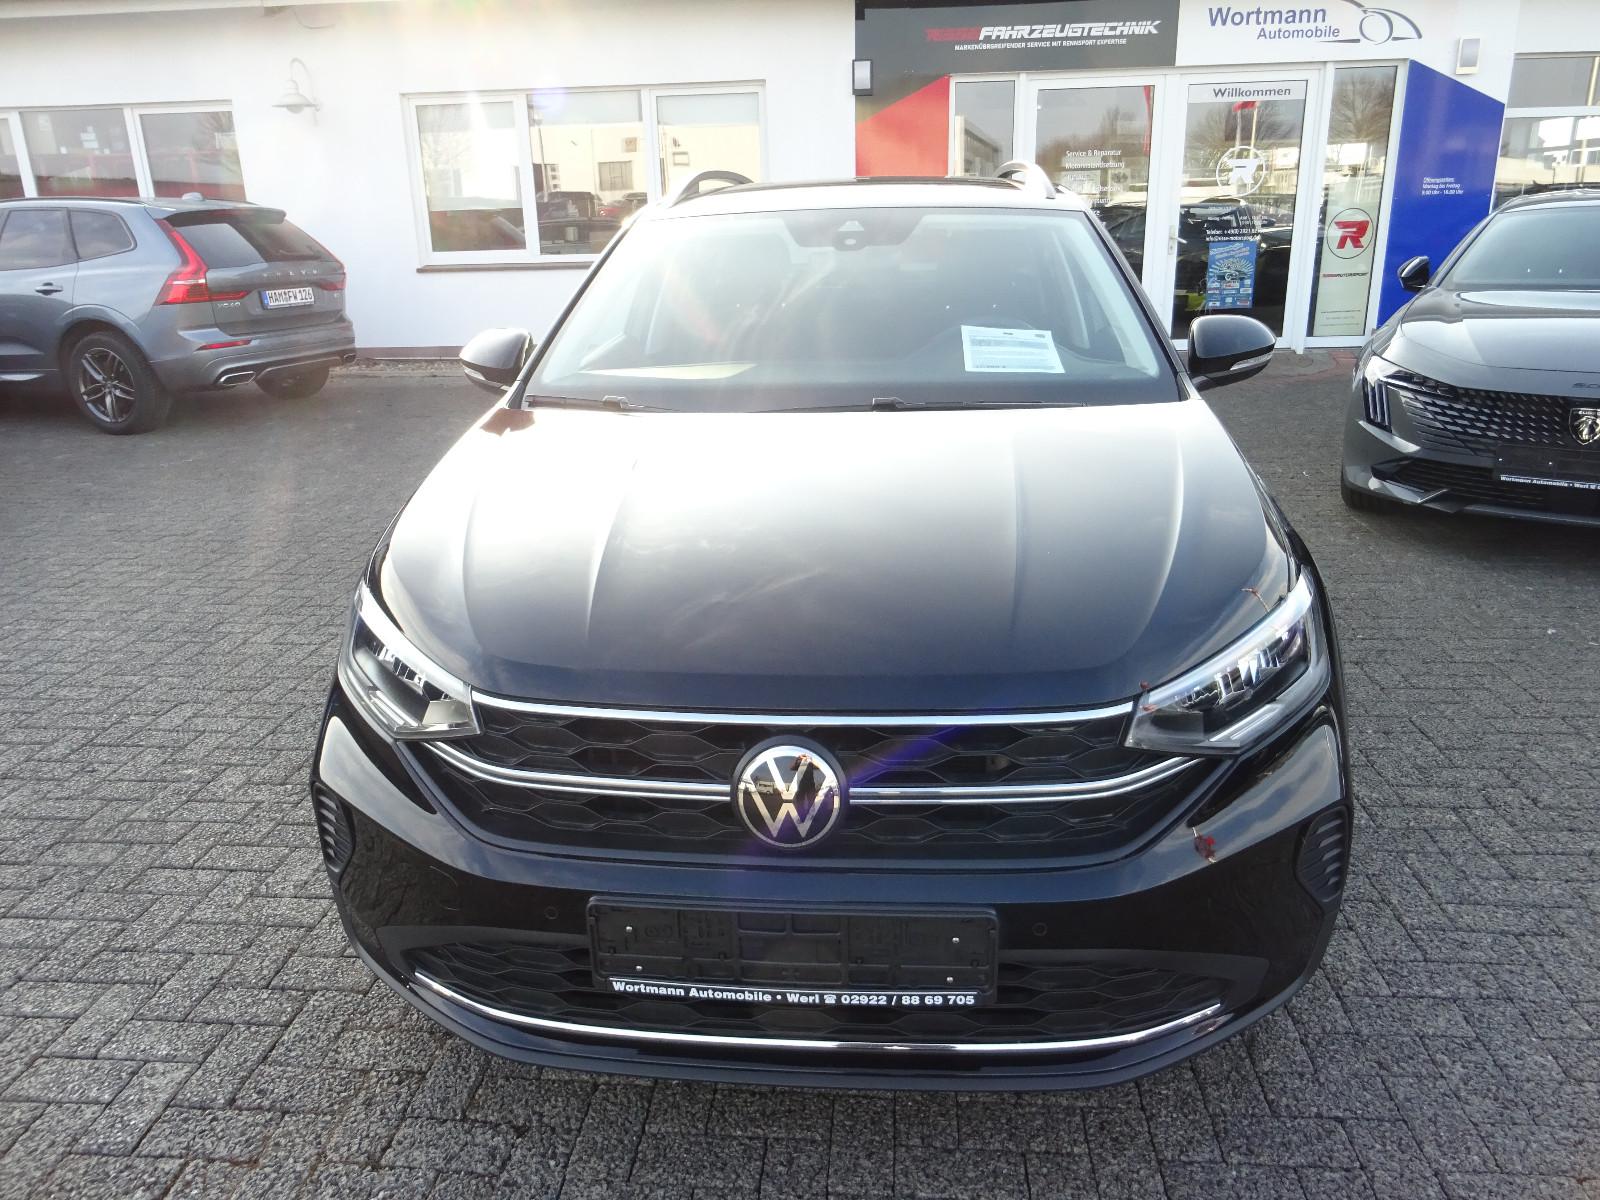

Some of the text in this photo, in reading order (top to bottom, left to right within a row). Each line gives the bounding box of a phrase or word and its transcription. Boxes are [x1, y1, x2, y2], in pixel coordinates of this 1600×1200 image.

[1208, 6, 1326, 26] Wortmann
[1257, 26, 1340, 40] Automobile
[1063, 39, 1096, 47] RENNSPORT
[1097, 38, 1127, 46] EXPERTISE
[1213, 87, 1291, 98] Willkommen
[1334, 220, 1370, 249] R
[268, 288, 313, 304] HAM FW 126
[612, 981, 685, 996] Wortmann
[689, 987, 772, 1002] Automobile
[786, 993, 820, 1004] Werl
[841, 994, 887, 1005] 02922
[901, 995, 920, 1005] 88
[924, 995, 943, 1005] 69
[947, 995, 975, 1005] 705
